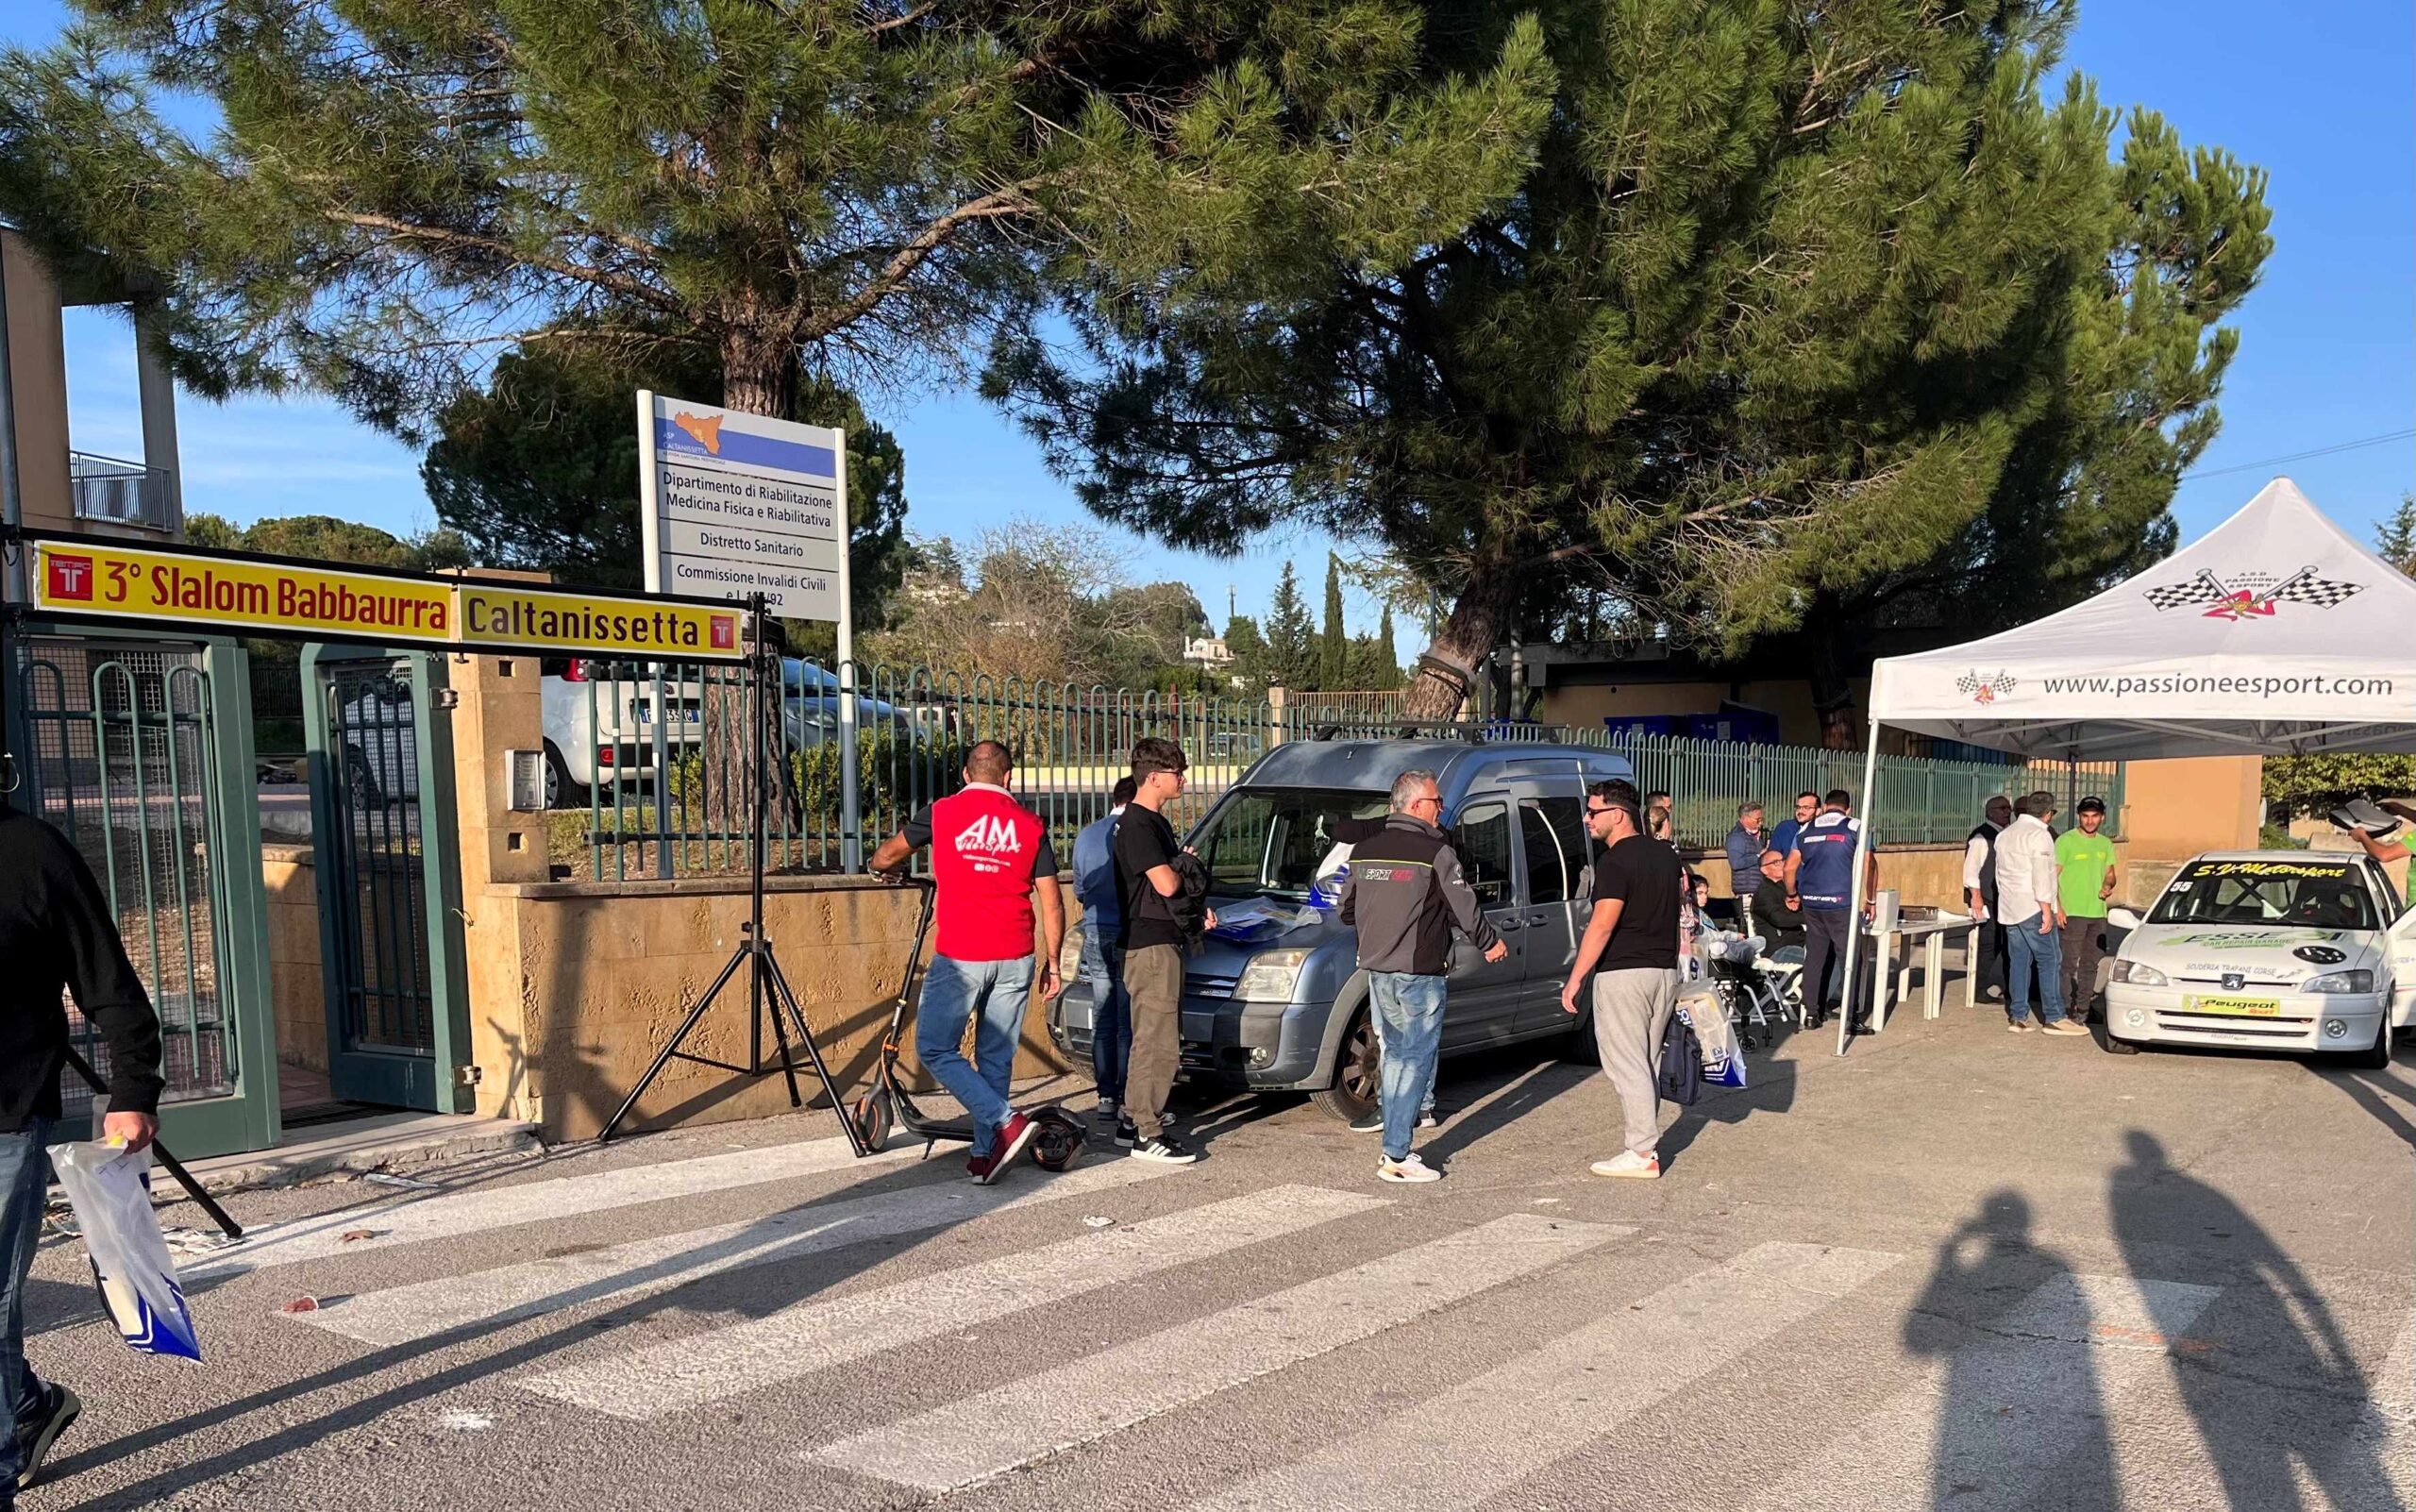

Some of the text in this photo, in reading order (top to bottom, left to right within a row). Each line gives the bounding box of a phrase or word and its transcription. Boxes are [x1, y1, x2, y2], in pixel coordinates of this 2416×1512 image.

[663, 472, 832, 509] Dipartimento di Riabilitazione
[666, 493, 830, 527] Medicina Fisica e Riabilitativa
[700, 532, 803, 557] Distretto Sanitario
[677, 564, 826, 592] Commissione Invalidi Civili
[105, 561, 446, 630] 3° Slalom Babbaurra
[468, 596, 698, 647] Caltanissetta
[2044, 673, 2393, 697] www.passioneesport.com
[956, 814, 1019, 848] AM
[2185, 963, 2277, 976] SCUDERIA TRAPANI CORSE
[2205, 999, 2276, 1010] Peugeot
